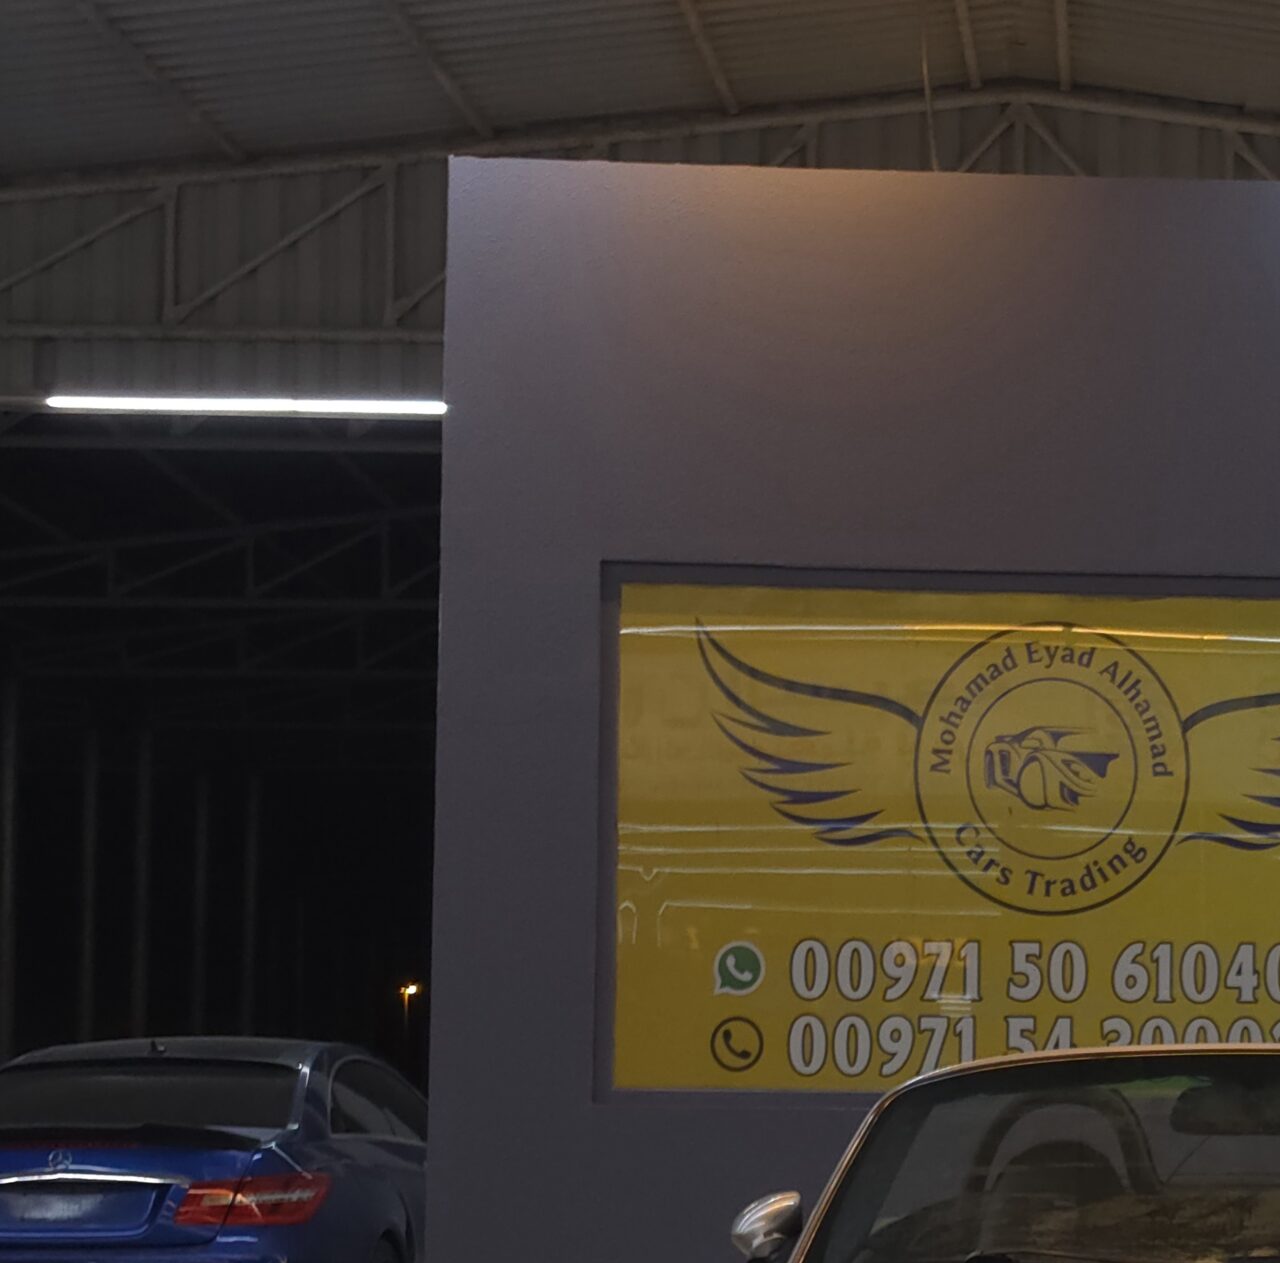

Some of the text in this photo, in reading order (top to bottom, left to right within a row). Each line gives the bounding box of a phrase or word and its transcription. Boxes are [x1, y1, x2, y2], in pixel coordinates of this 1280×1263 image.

[929, 641, 1174, 777] Mohamad Eyad Alhamad
[955, 822, 1148, 898] Cars Trading
[789, 938, 982, 1002] 00971
[1006, 940, 1089, 1003] 50
[787, 1013, 976, 1077] 00971
